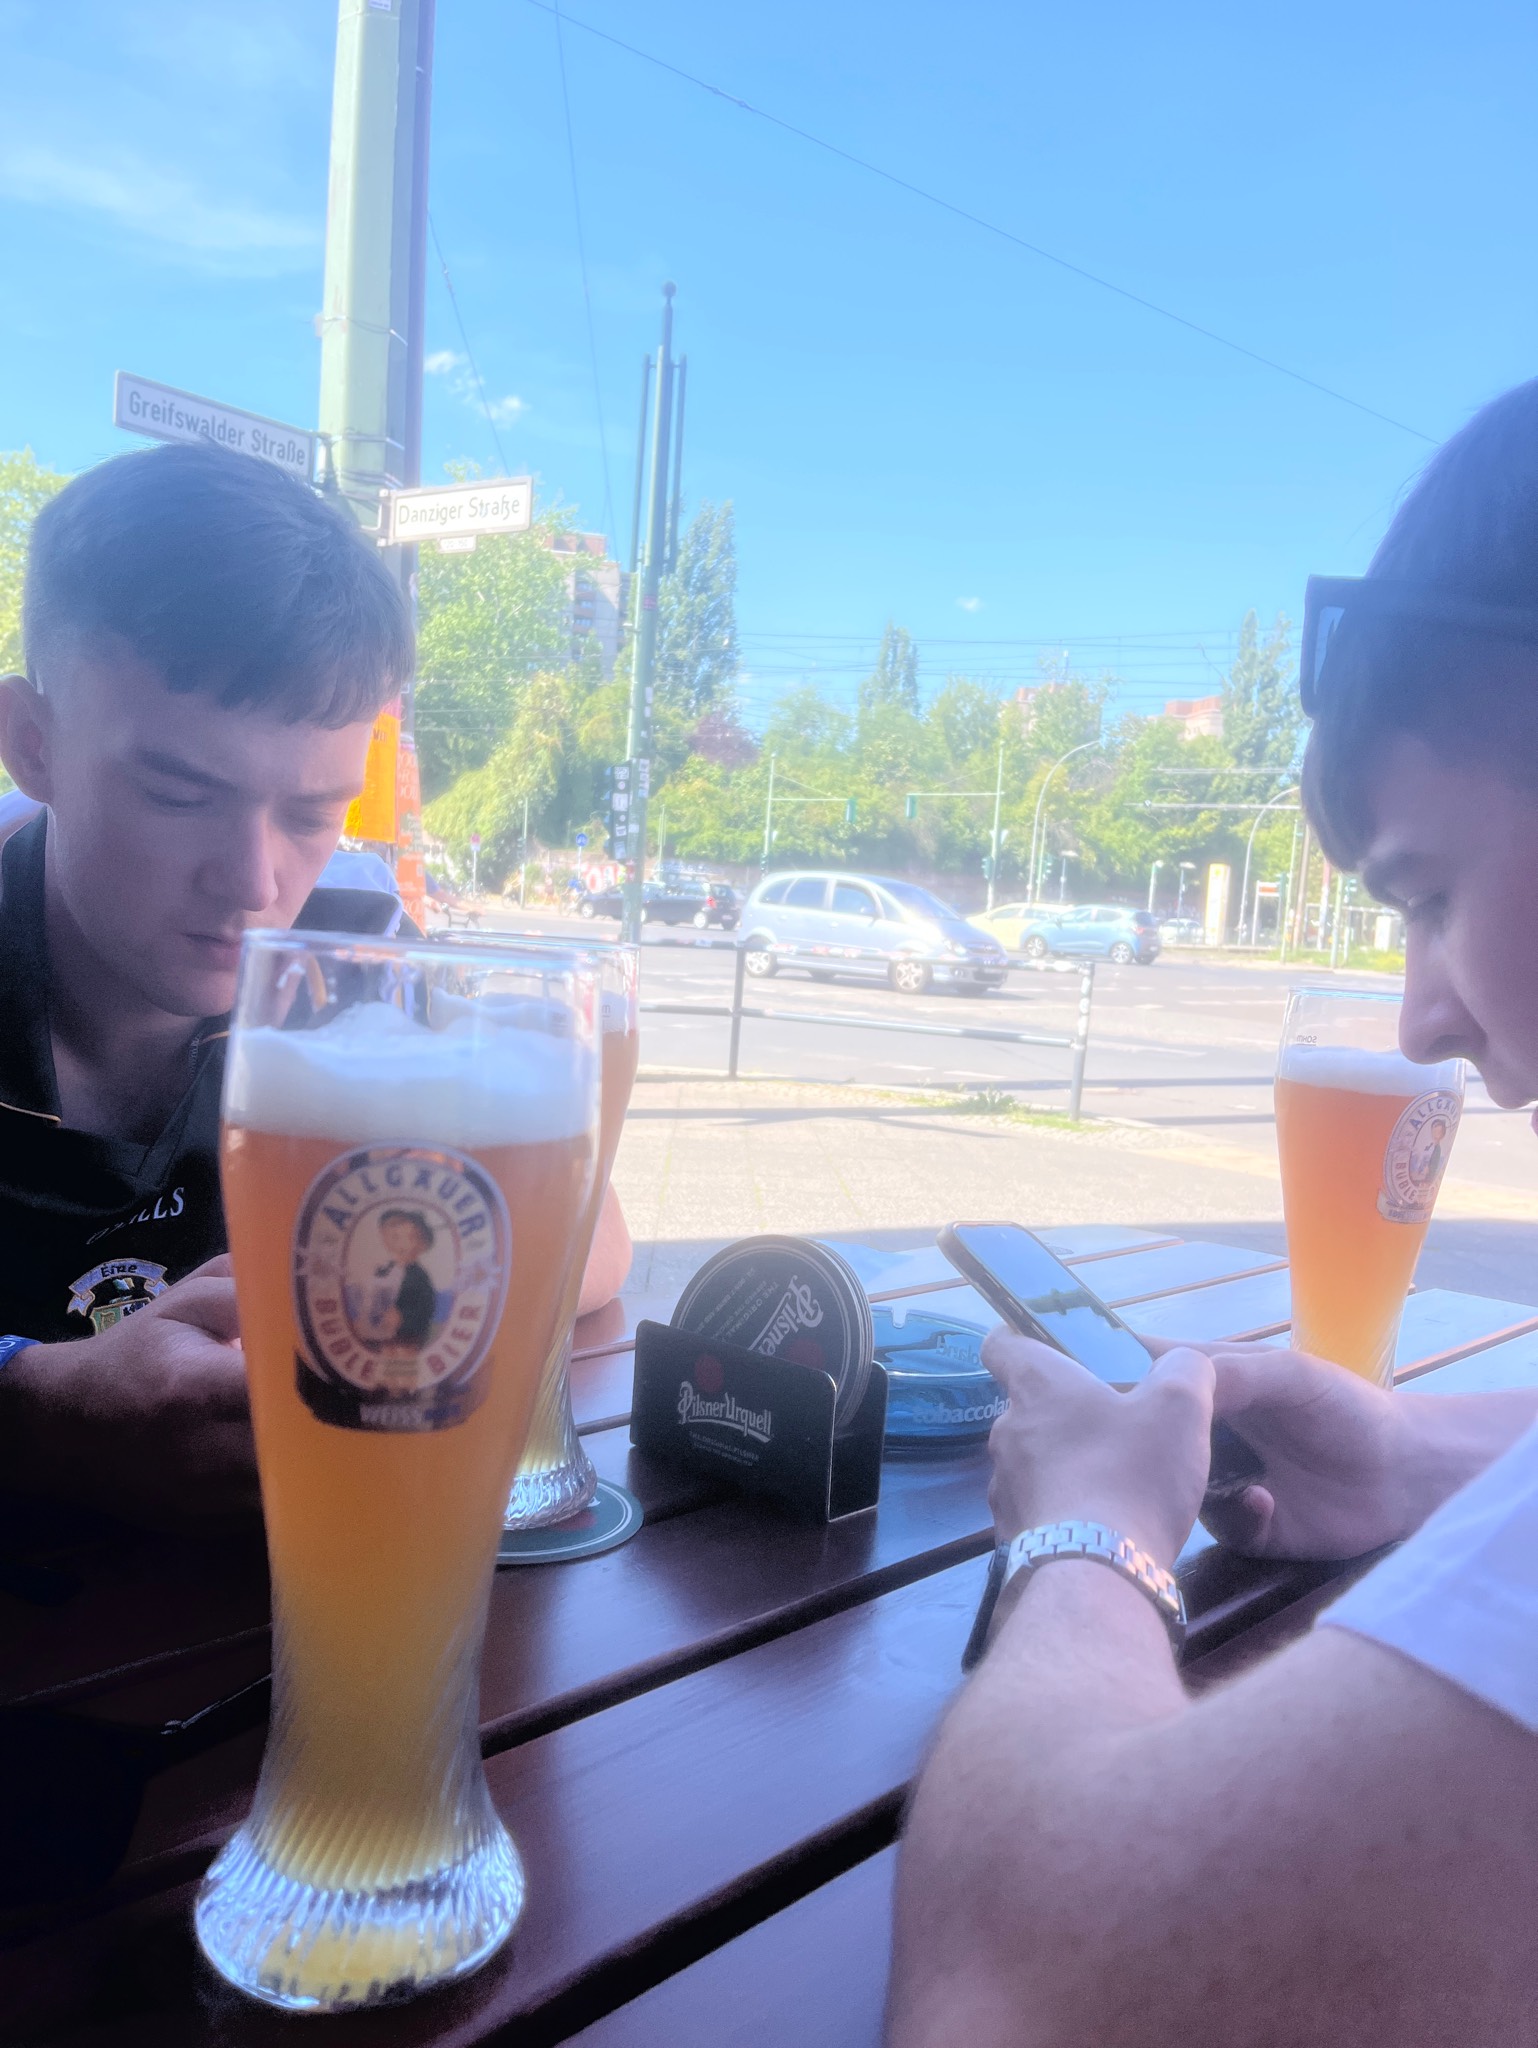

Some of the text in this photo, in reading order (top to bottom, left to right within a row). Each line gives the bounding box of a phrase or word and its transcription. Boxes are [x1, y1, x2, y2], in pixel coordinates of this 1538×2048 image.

[129, 390, 307, 466] Greifswalder Straße
[398, 494, 520, 526] Danziger Straße
